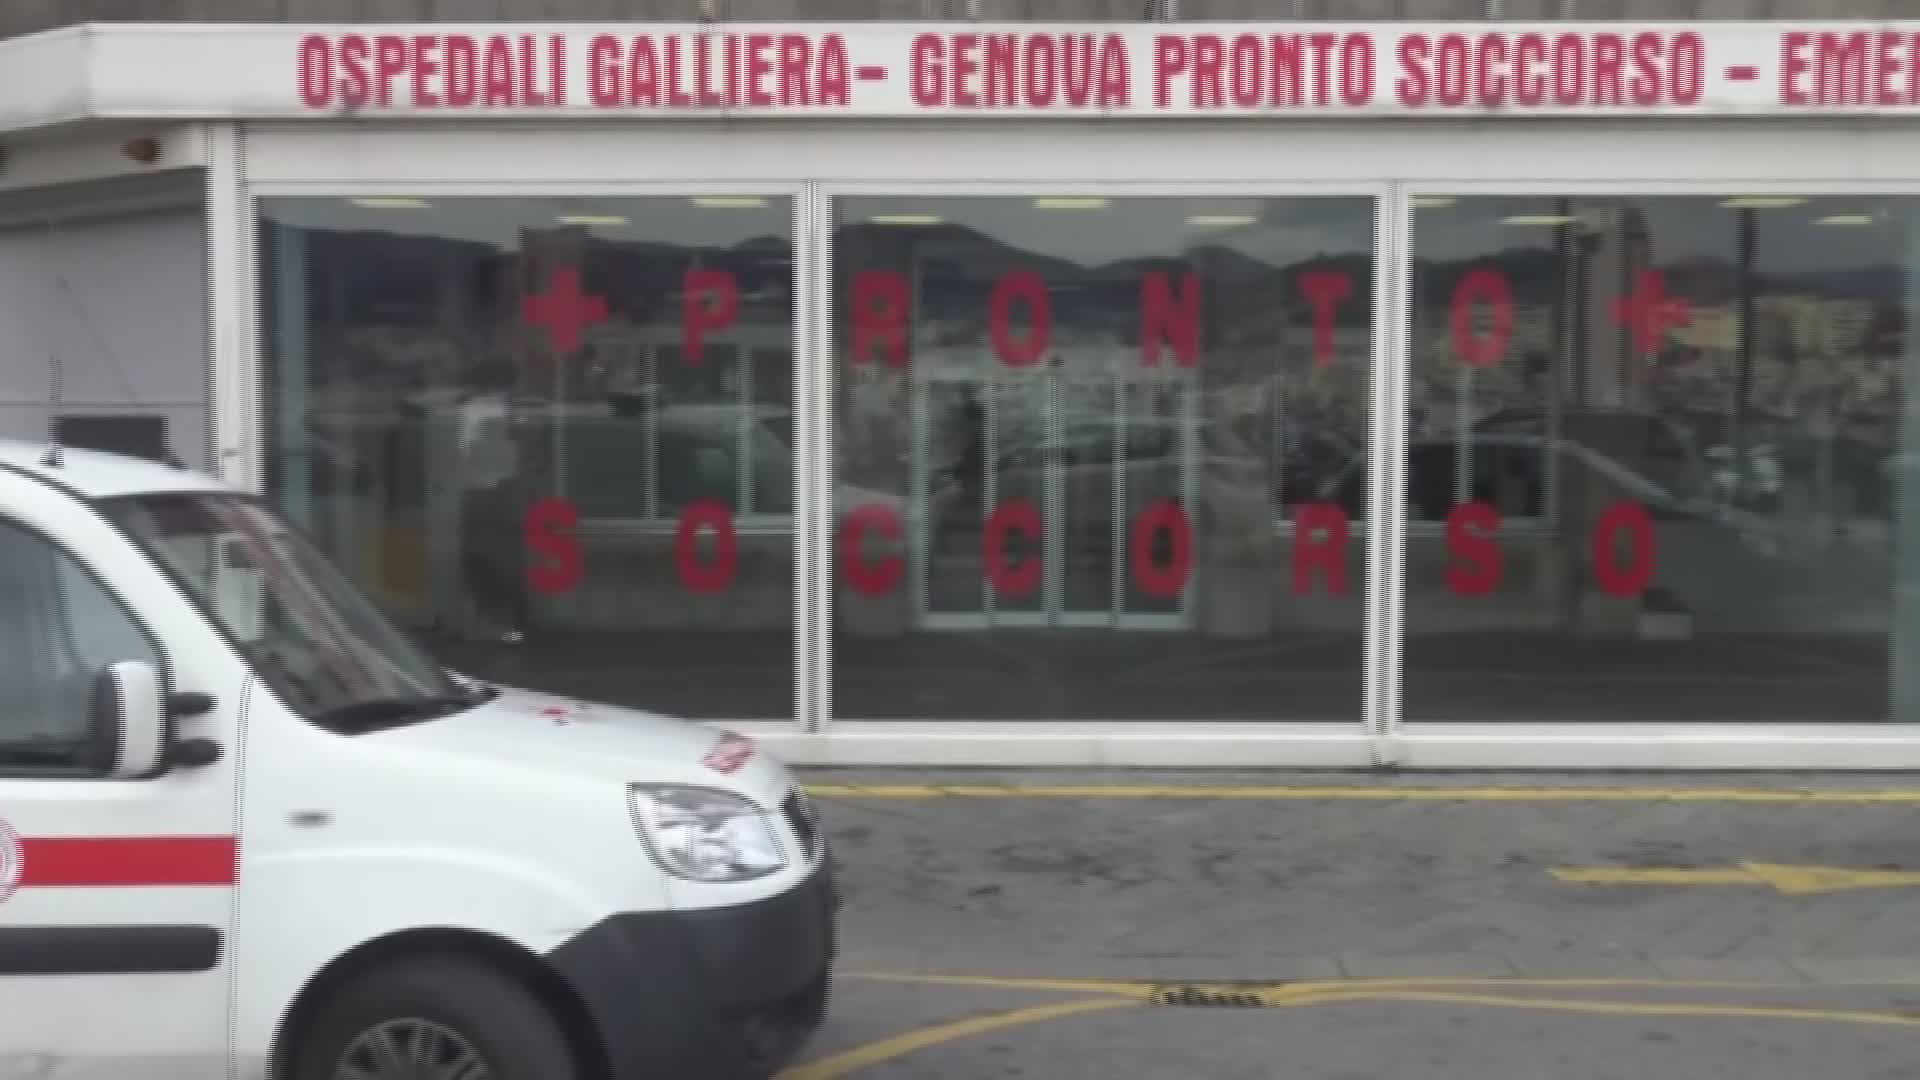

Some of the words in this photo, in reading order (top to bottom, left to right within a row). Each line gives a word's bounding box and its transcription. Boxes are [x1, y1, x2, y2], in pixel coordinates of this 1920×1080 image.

[298, 33, 567, 107] OSPEDALI
[909, 33, 1132, 107] GENOVA
[1152, 33, 1377, 106] PRONTO
[1396, 32, 1705, 106] SOCCORSO
[680, 270, 1514, 367] PRONTO
[523, 499, 1657, 598] SOCCORSO
